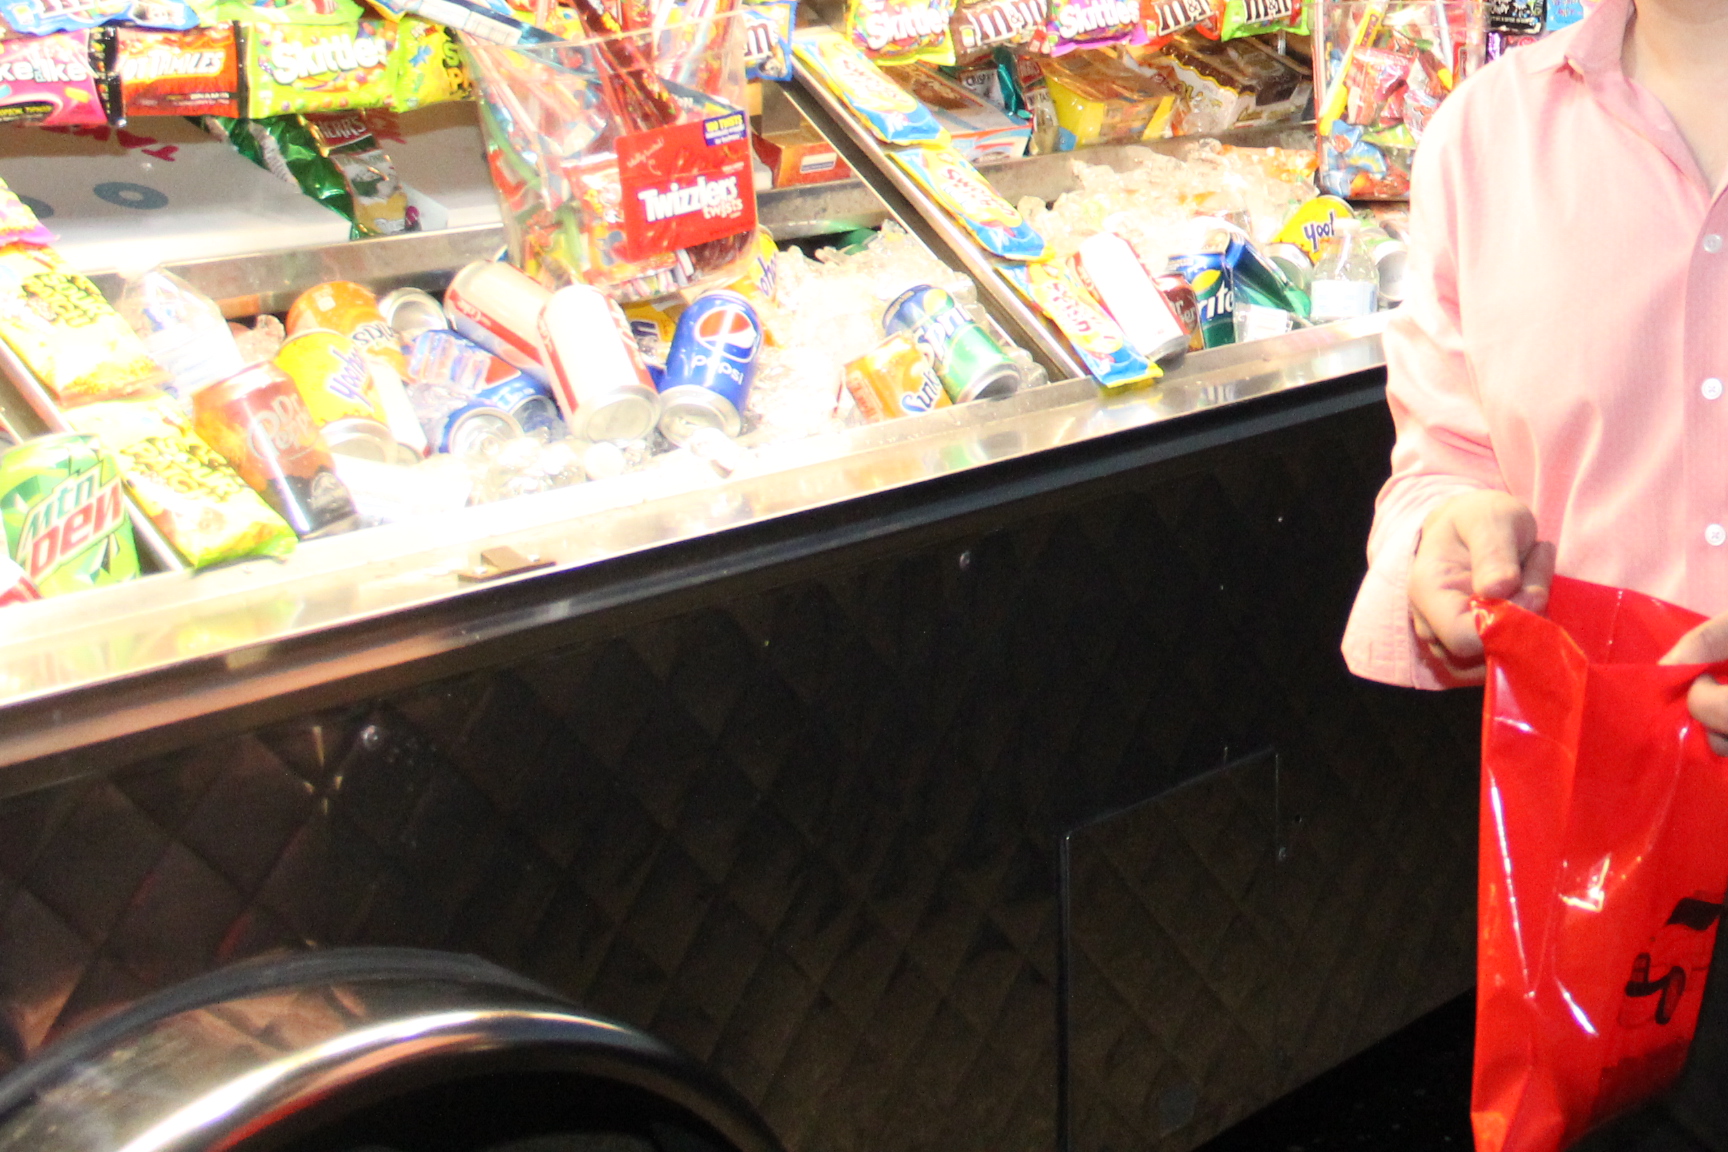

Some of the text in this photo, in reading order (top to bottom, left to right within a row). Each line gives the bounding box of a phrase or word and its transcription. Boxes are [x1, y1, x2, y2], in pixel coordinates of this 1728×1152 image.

[864, 5, 950, 51] Skittles
[271, 34, 389, 85] Skittles
[637, 174, 739, 223] Twizzlers
[702, 198, 744, 219] twists
[691, 353, 745, 386] pepsi
